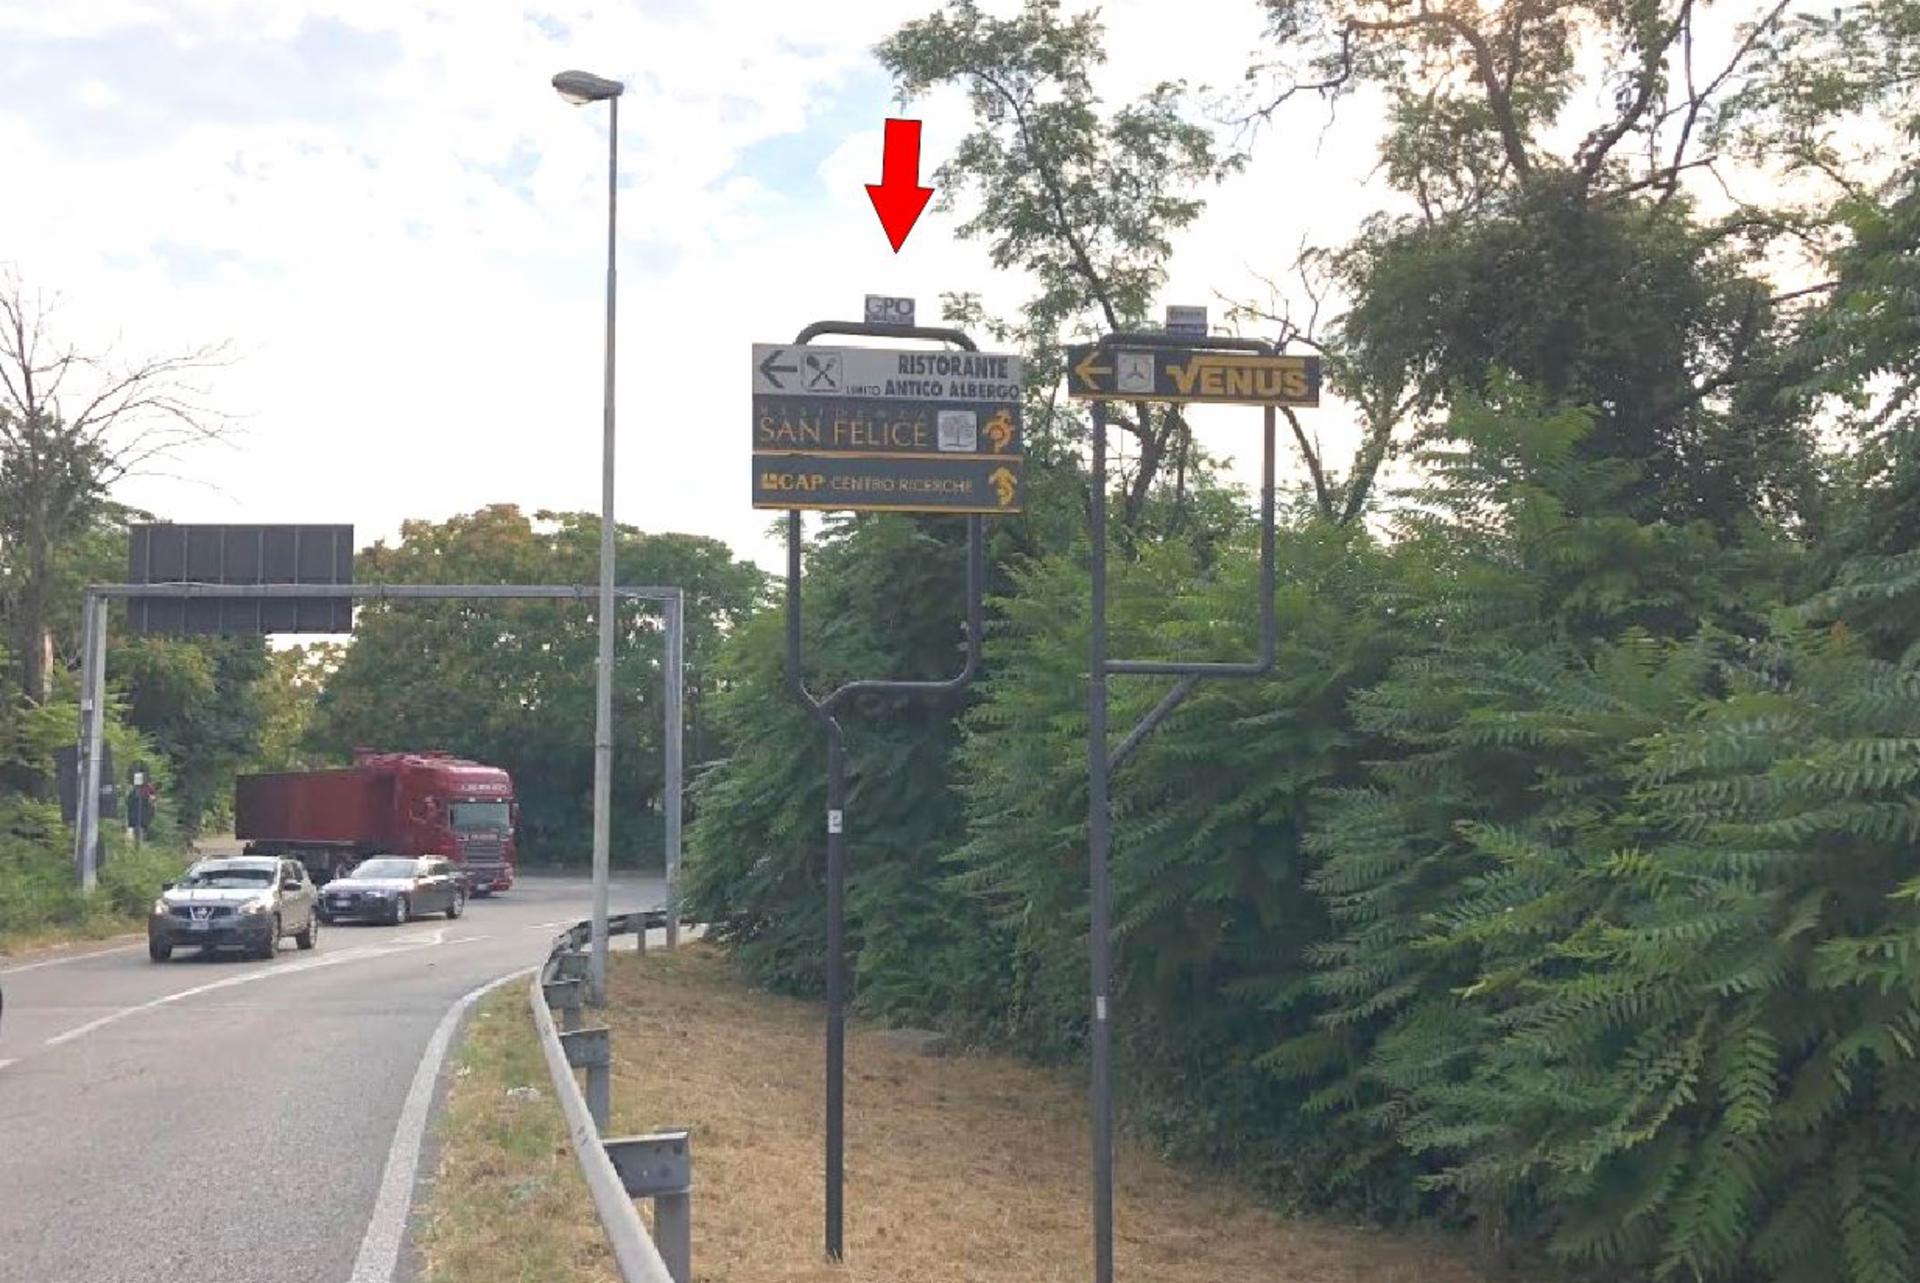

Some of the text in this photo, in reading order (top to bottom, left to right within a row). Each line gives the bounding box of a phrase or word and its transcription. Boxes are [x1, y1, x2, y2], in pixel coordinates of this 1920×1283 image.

[865, 296, 915, 321] GPO
[898, 353, 1009, 380] RISTORANTE
[1166, 355, 1308, 398] VENUS
[885, 378, 943, 397] ANTICO
[949, 380, 1021, 399] ALBERGO
[759, 416, 928, 447] SAN FELICE
[779, 472, 973, 494] CAP CENTRO RICERCHE
